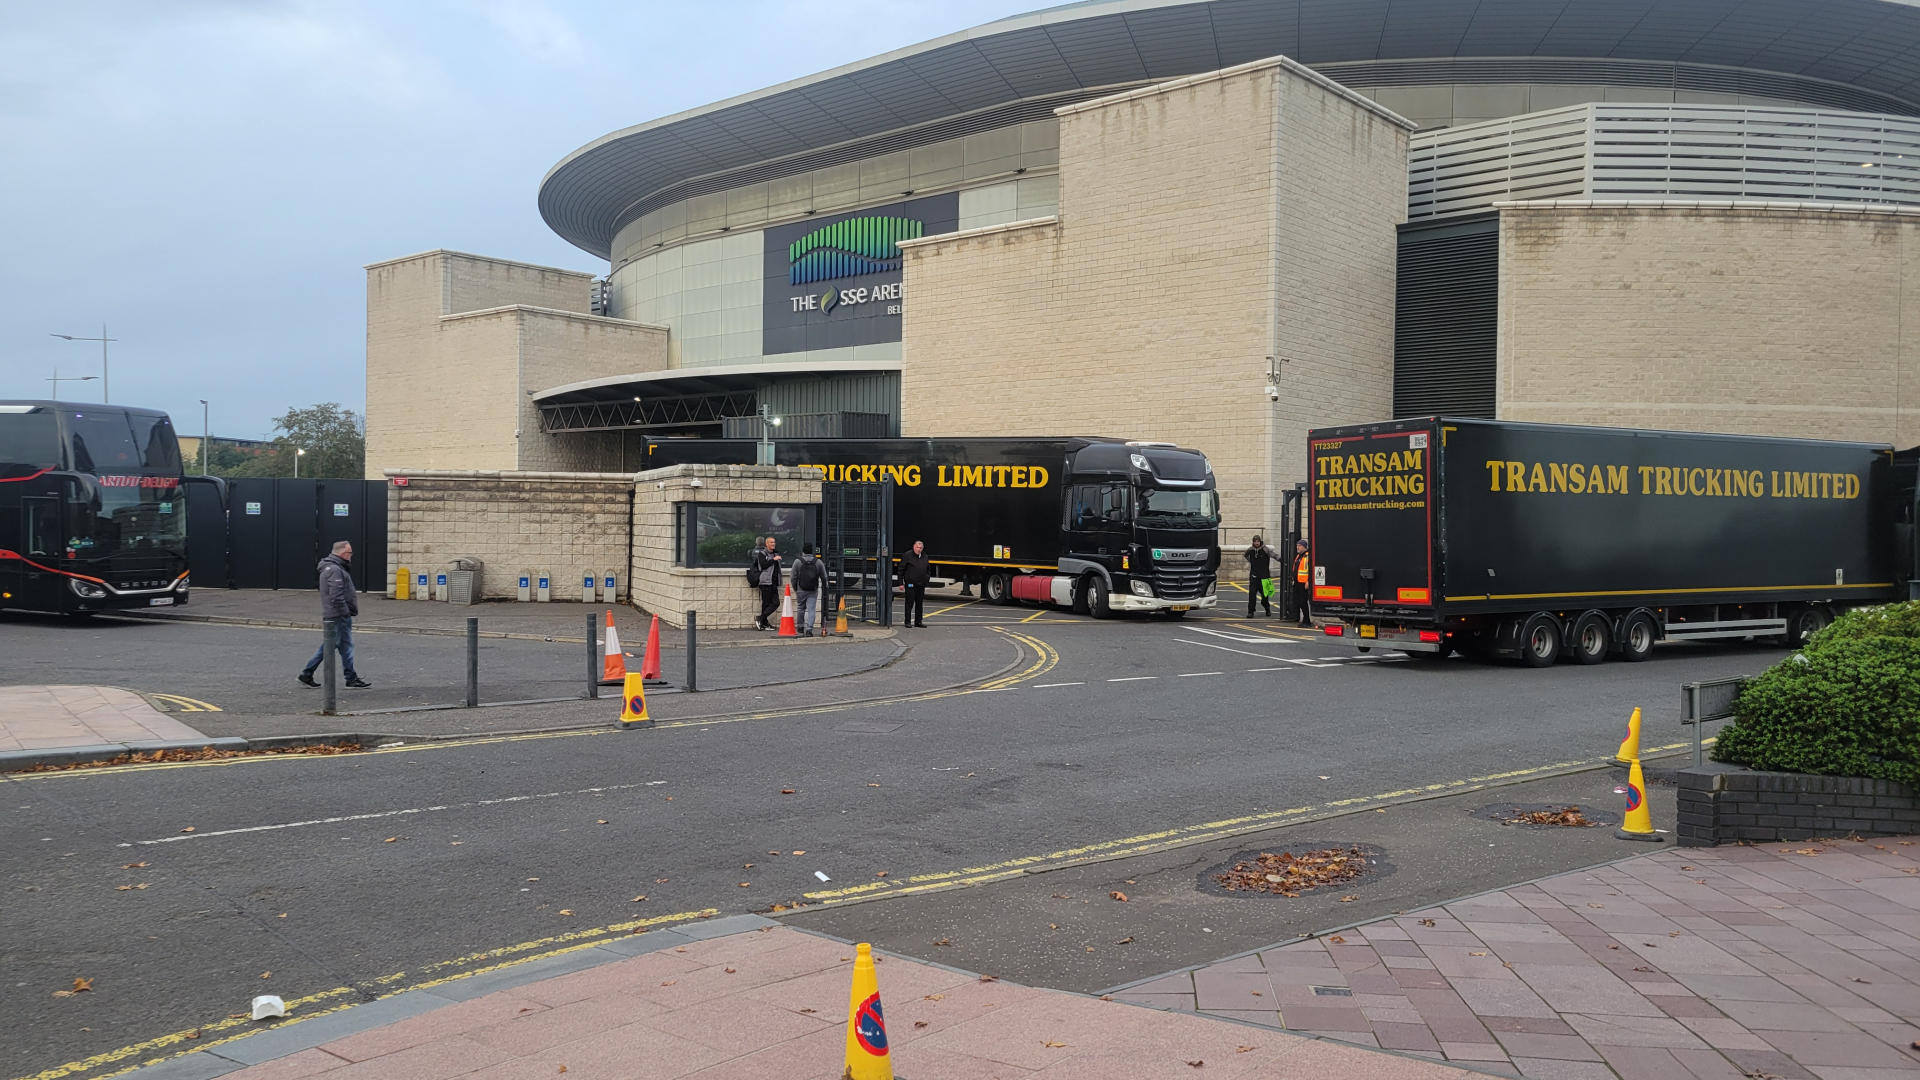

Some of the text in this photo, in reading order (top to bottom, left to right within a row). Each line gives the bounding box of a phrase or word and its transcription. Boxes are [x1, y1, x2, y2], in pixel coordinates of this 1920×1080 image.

[791, 294, 818, 312] THE
[1314, 441, 1343, 450] TT23327
[1317, 450, 1423, 476] TRANSAM
[798, 464, 1049, 488] RUCKING LIMITED
[1315, 474, 1425, 498] TRUCKING
[1486, 460, 1860, 499] TRANSAM TRUCKING LIMITED
[1315, 500, 1425, 511] www.transamtrucking.com
[120, 580, 168, 588] SETRA
